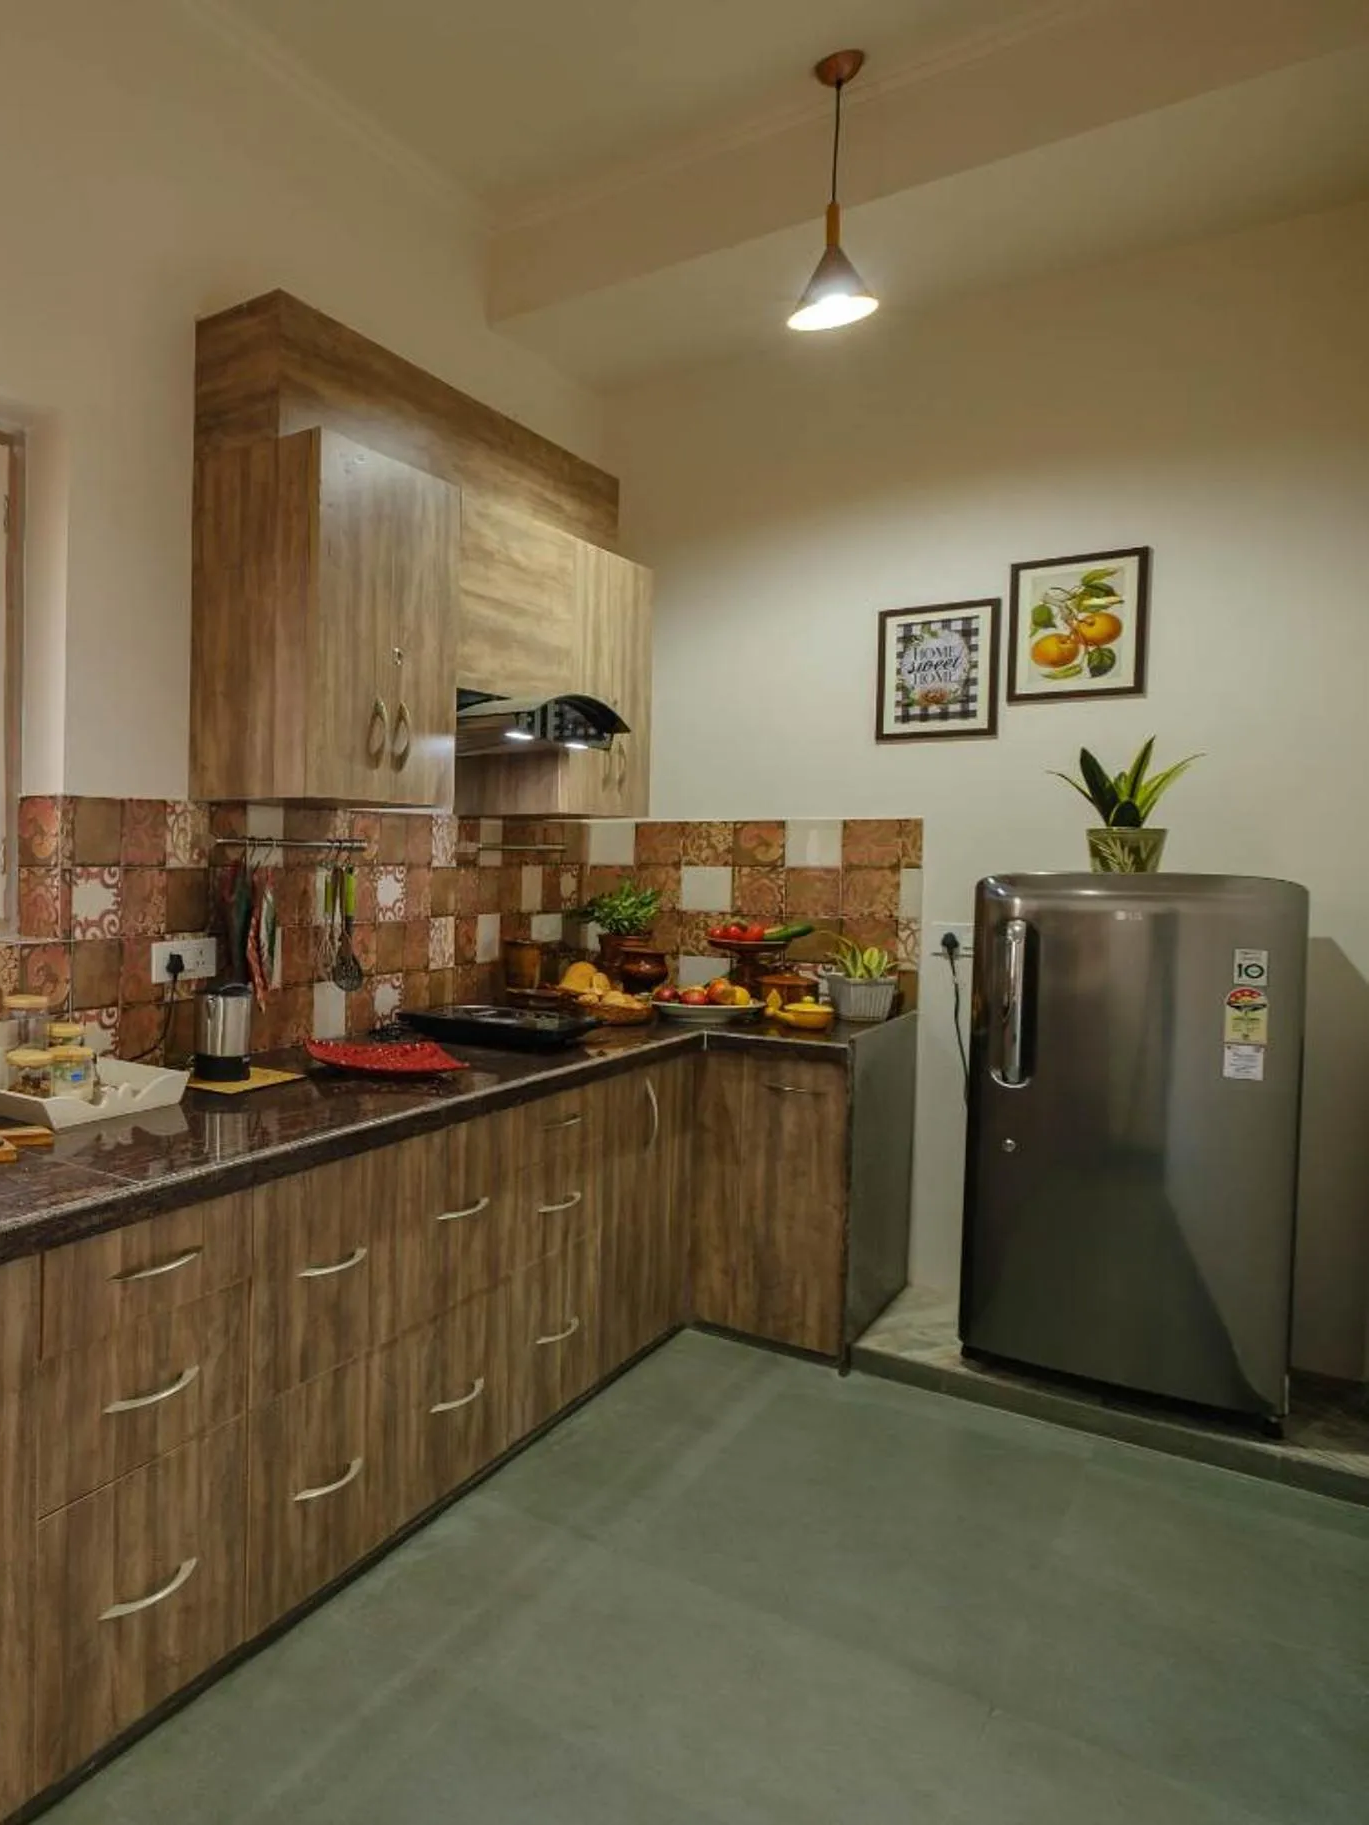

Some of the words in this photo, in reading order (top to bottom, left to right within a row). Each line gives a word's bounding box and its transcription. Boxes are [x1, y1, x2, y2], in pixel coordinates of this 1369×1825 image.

[913, 645, 955, 661] HOME
[913, 670, 954, 685] HOME
[1238, 963, 1264, 979] 10
